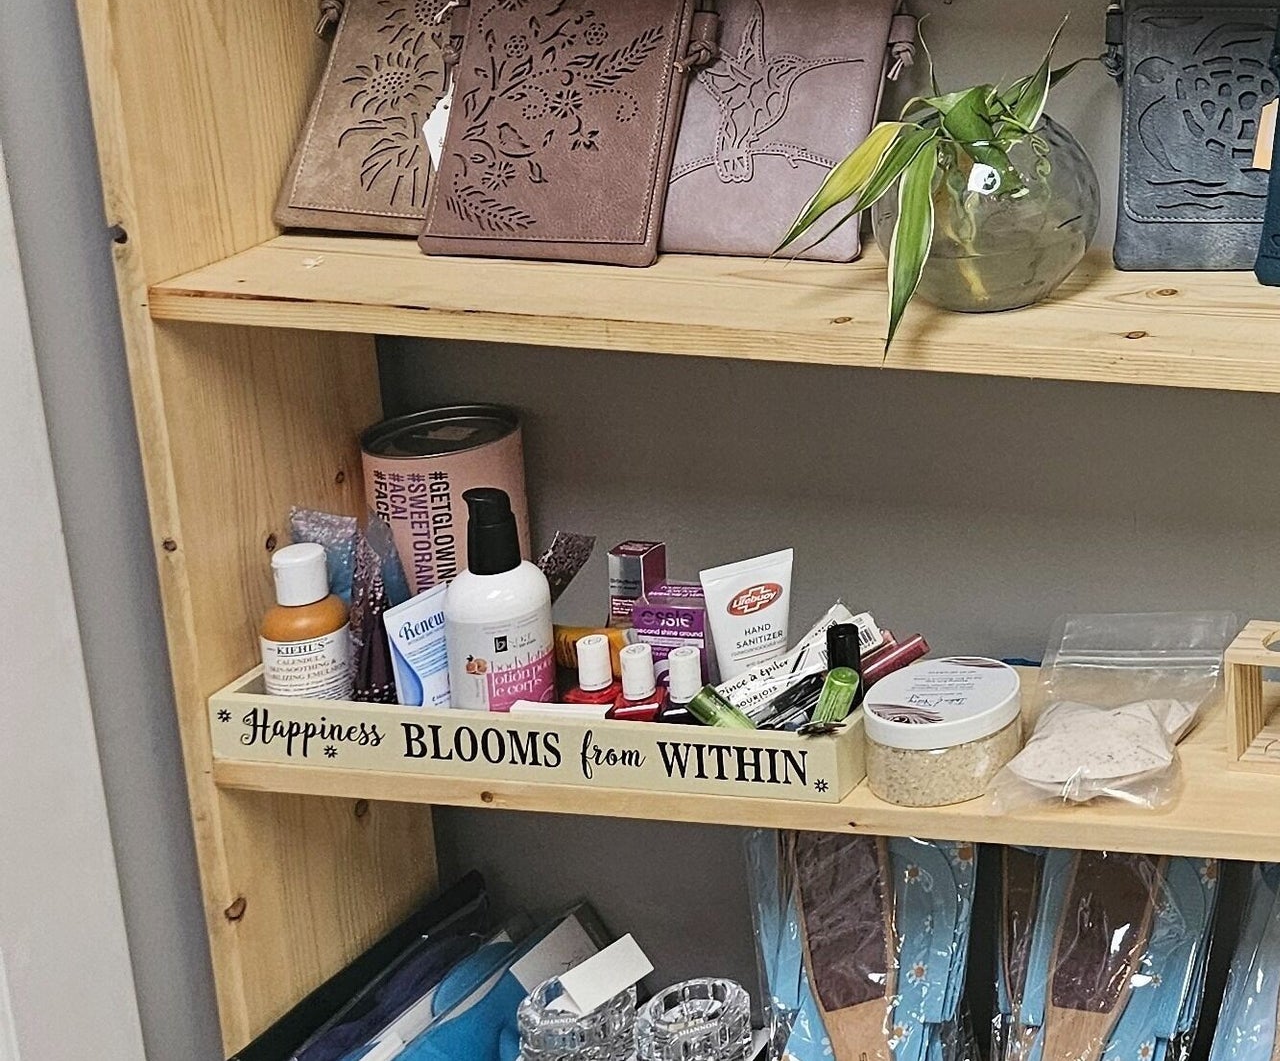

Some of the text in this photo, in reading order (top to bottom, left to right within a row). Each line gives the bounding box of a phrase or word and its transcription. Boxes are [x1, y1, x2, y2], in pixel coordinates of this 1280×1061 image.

[373, 470, 391, 528] #FACE
[388, 473, 408, 520] #ACAI
[428, 471, 458, 585] #GETGLOWIN
[733, 591, 777, 608] Lifebuoy
[661, 629, 678, 637] shine
[679, 630, 704, 638] around
[736, 630, 784, 649] SANITIZER
[744, 623, 771, 636] HAND
[241, 707, 809, 787] Happiness BLOOMS from WITHIN
